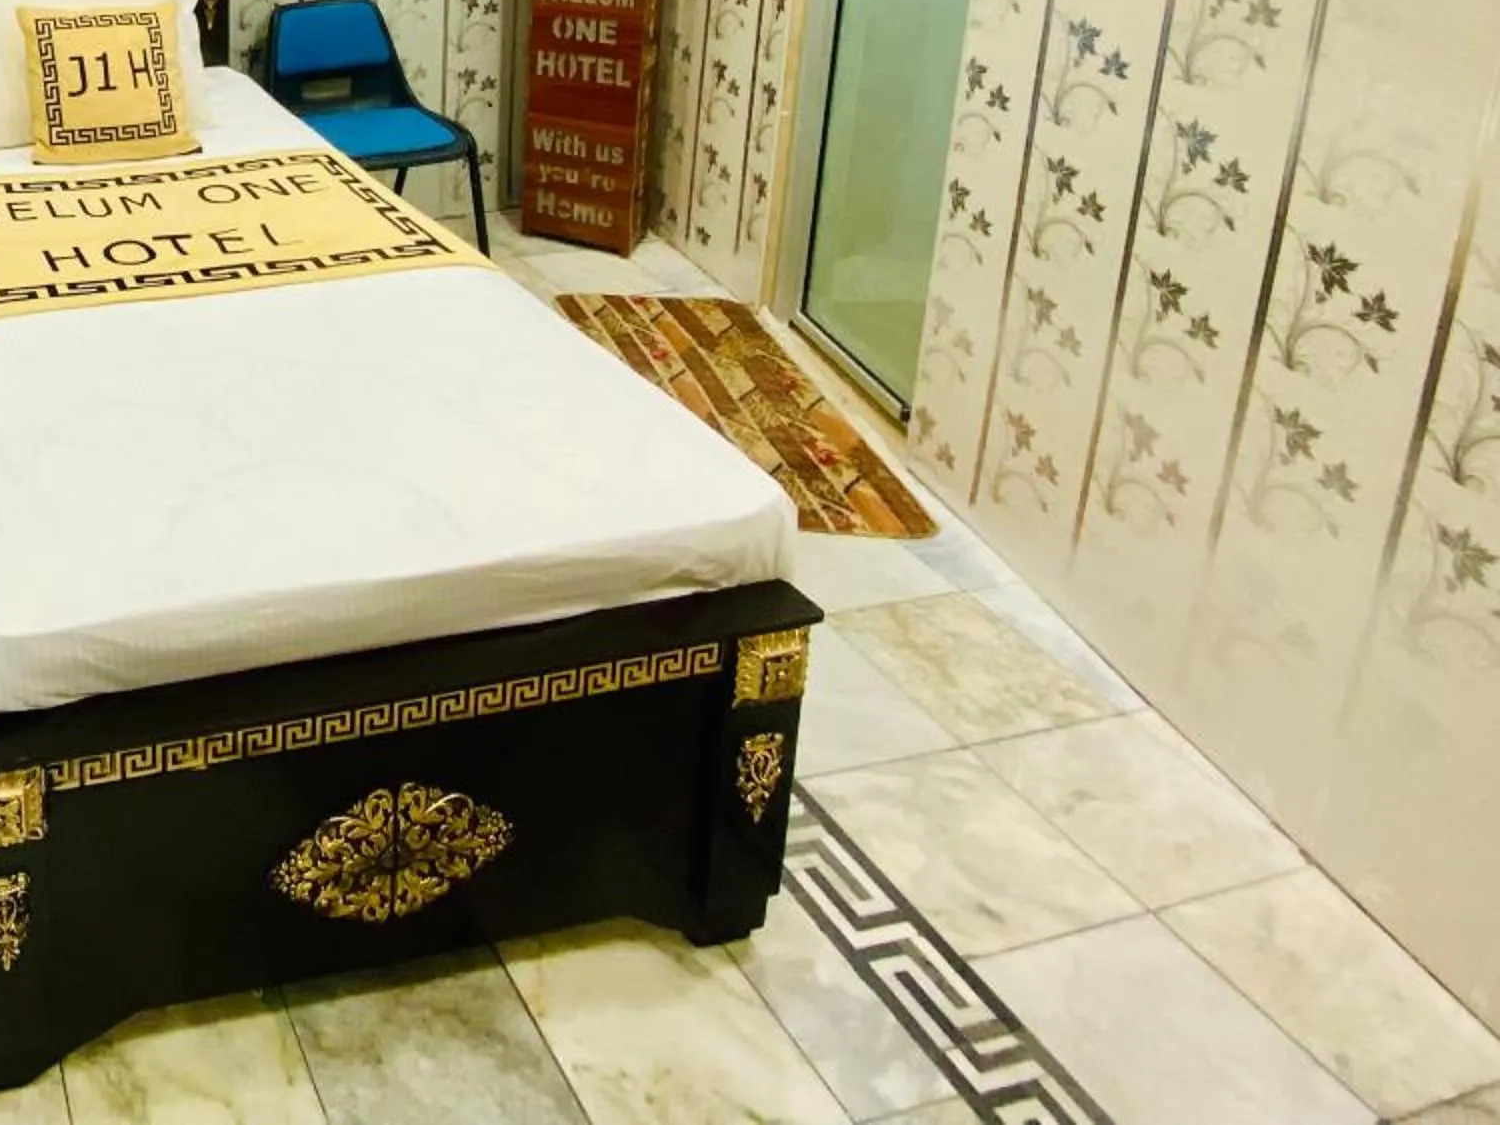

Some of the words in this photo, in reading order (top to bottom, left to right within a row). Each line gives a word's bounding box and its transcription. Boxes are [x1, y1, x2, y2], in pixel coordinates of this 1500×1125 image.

[552, 15, 618, 46] ONE
[536, 50, 632, 88] HOTEL
[532, 127, 587, 159] With
[595, 142, 625, 165] us
[198, 175, 328, 205] ONE
[536, 188, 613, 228] Home
[42, 223, 303, 272] HOTEL
